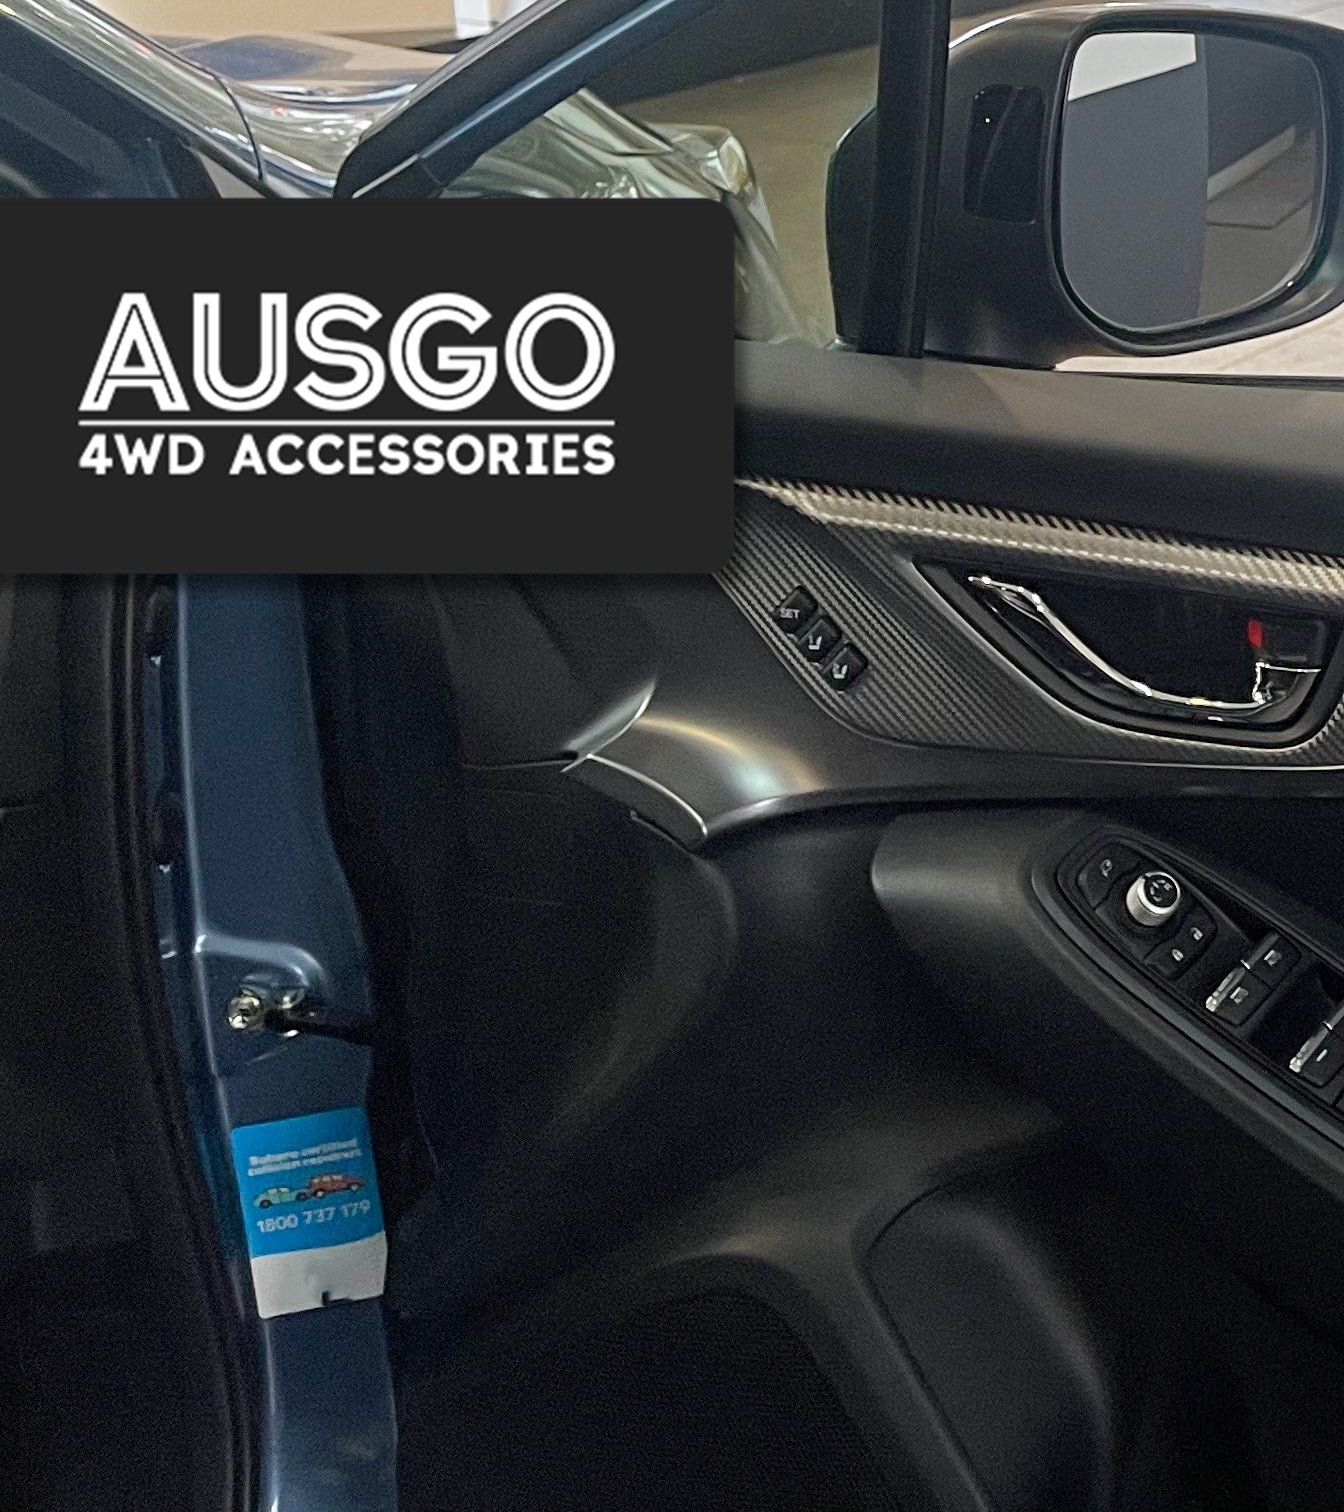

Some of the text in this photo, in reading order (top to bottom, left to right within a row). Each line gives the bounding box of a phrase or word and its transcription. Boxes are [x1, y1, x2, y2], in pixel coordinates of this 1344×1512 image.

[780, 608, 800, 619] SET
[257, 1213, 299, 1233] 1800
[302, 1206, 336, 1225] 737
